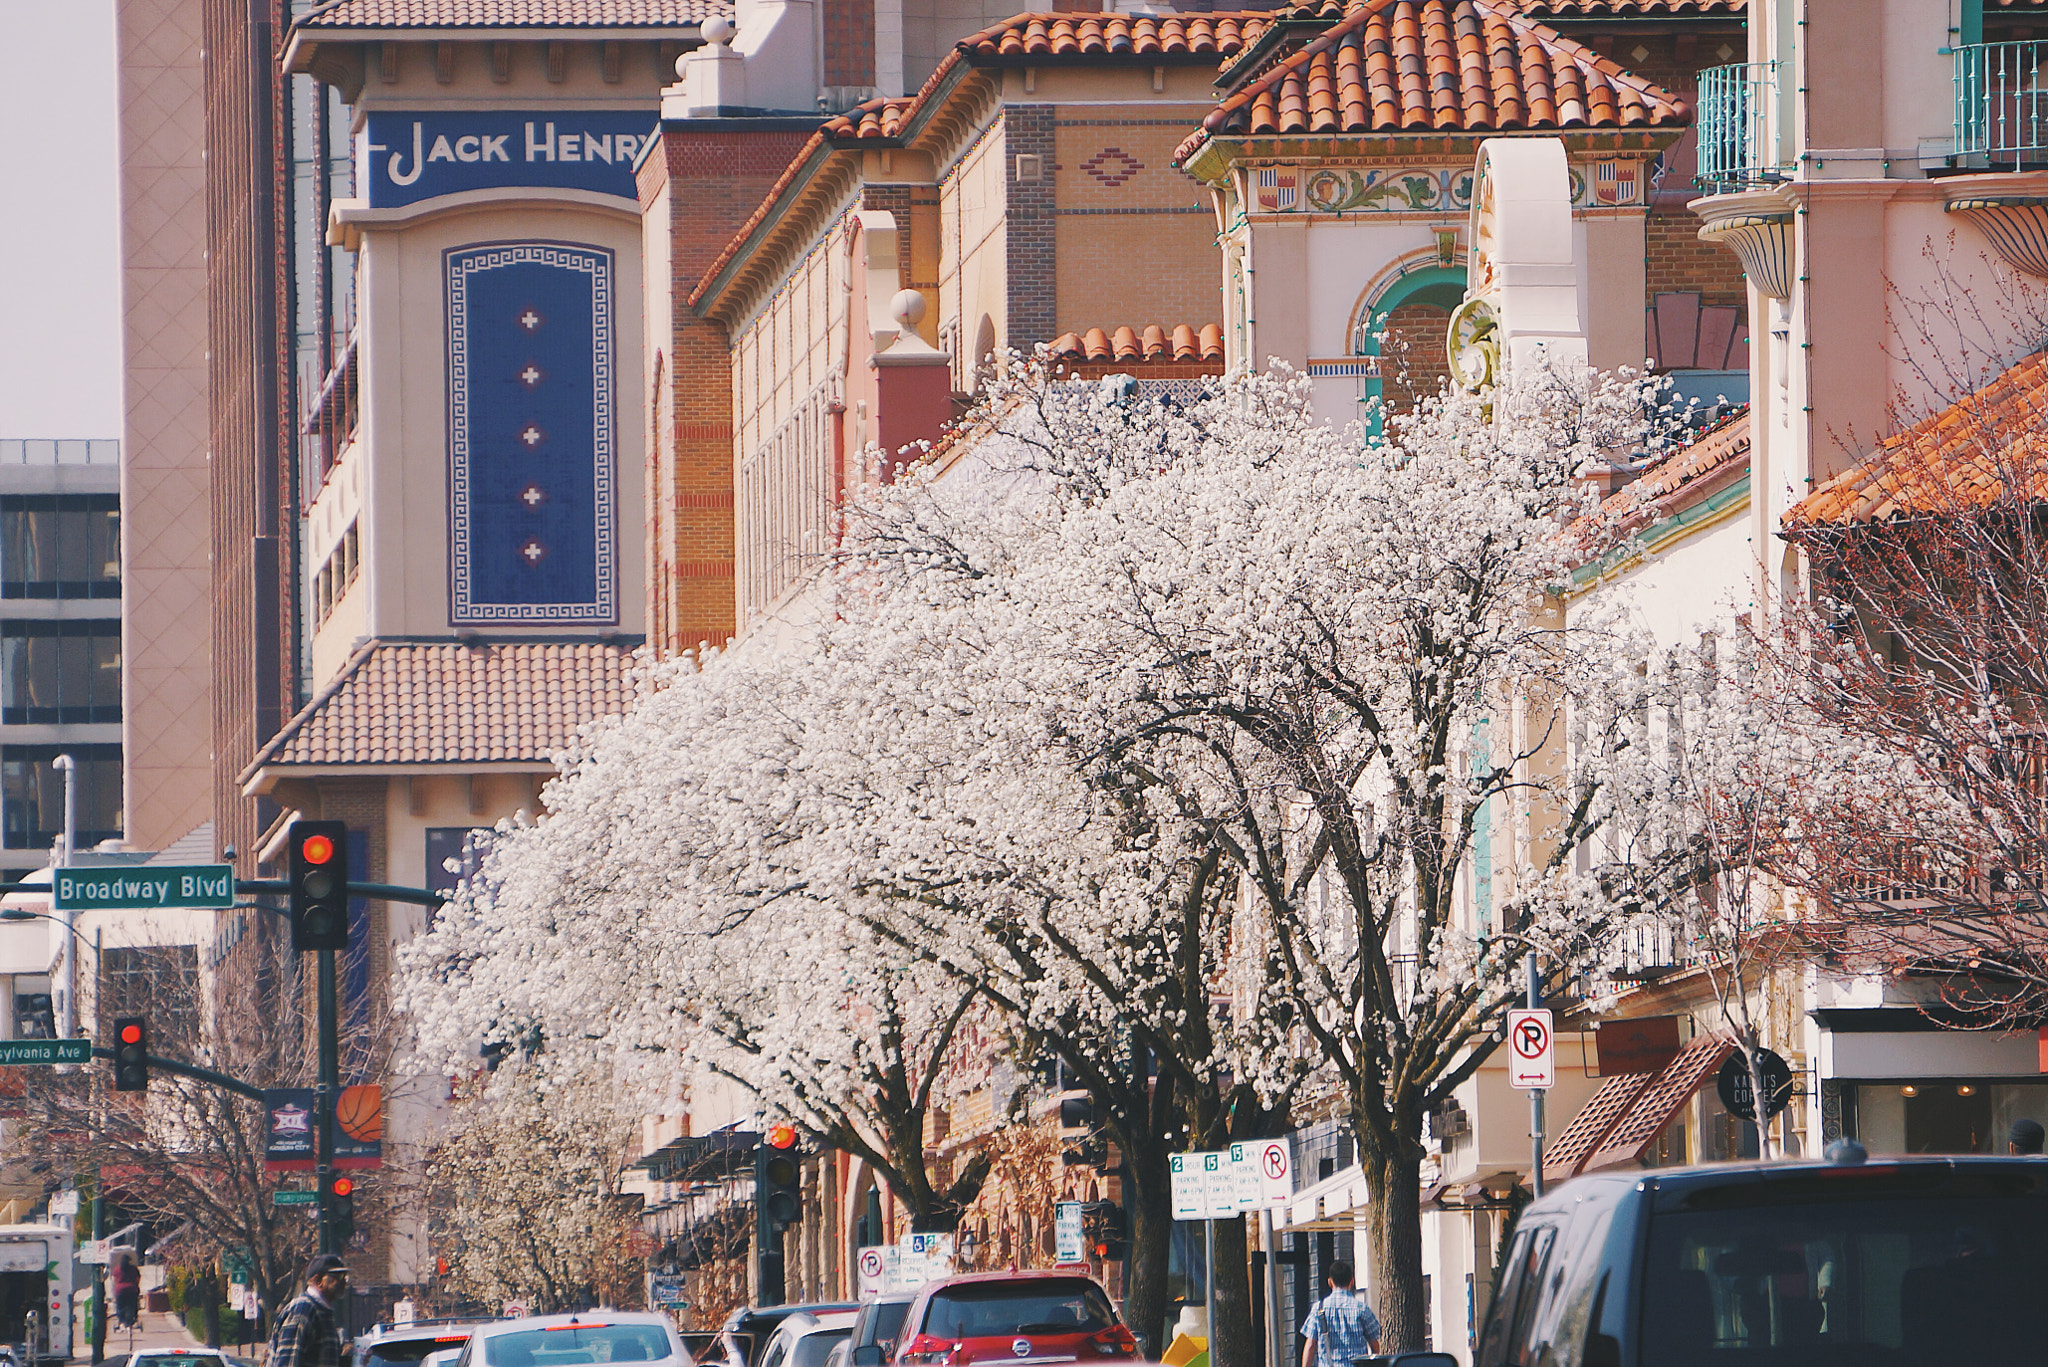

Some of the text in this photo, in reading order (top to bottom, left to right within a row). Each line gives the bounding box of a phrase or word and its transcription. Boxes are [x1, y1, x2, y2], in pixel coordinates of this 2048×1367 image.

[388, 121, 647, 186] JACK HENR
[60, 875, 227, 904] Broadway Blvd
[57, 1045, 80, 1058] Ave
[1734, 1074, 1776, 1088] KALI'S
[1734, 1088, 1776, 1103] COFEE
[1232, 1146, 1242, 1160] 15
[1174, 1158, 1182, 1171] 2
[1206, 1156, 1217, 1170] 15
[1176, 1176, 1199, 1184] PARKING
[1209, 1174, 1232, 1183] PARKING
